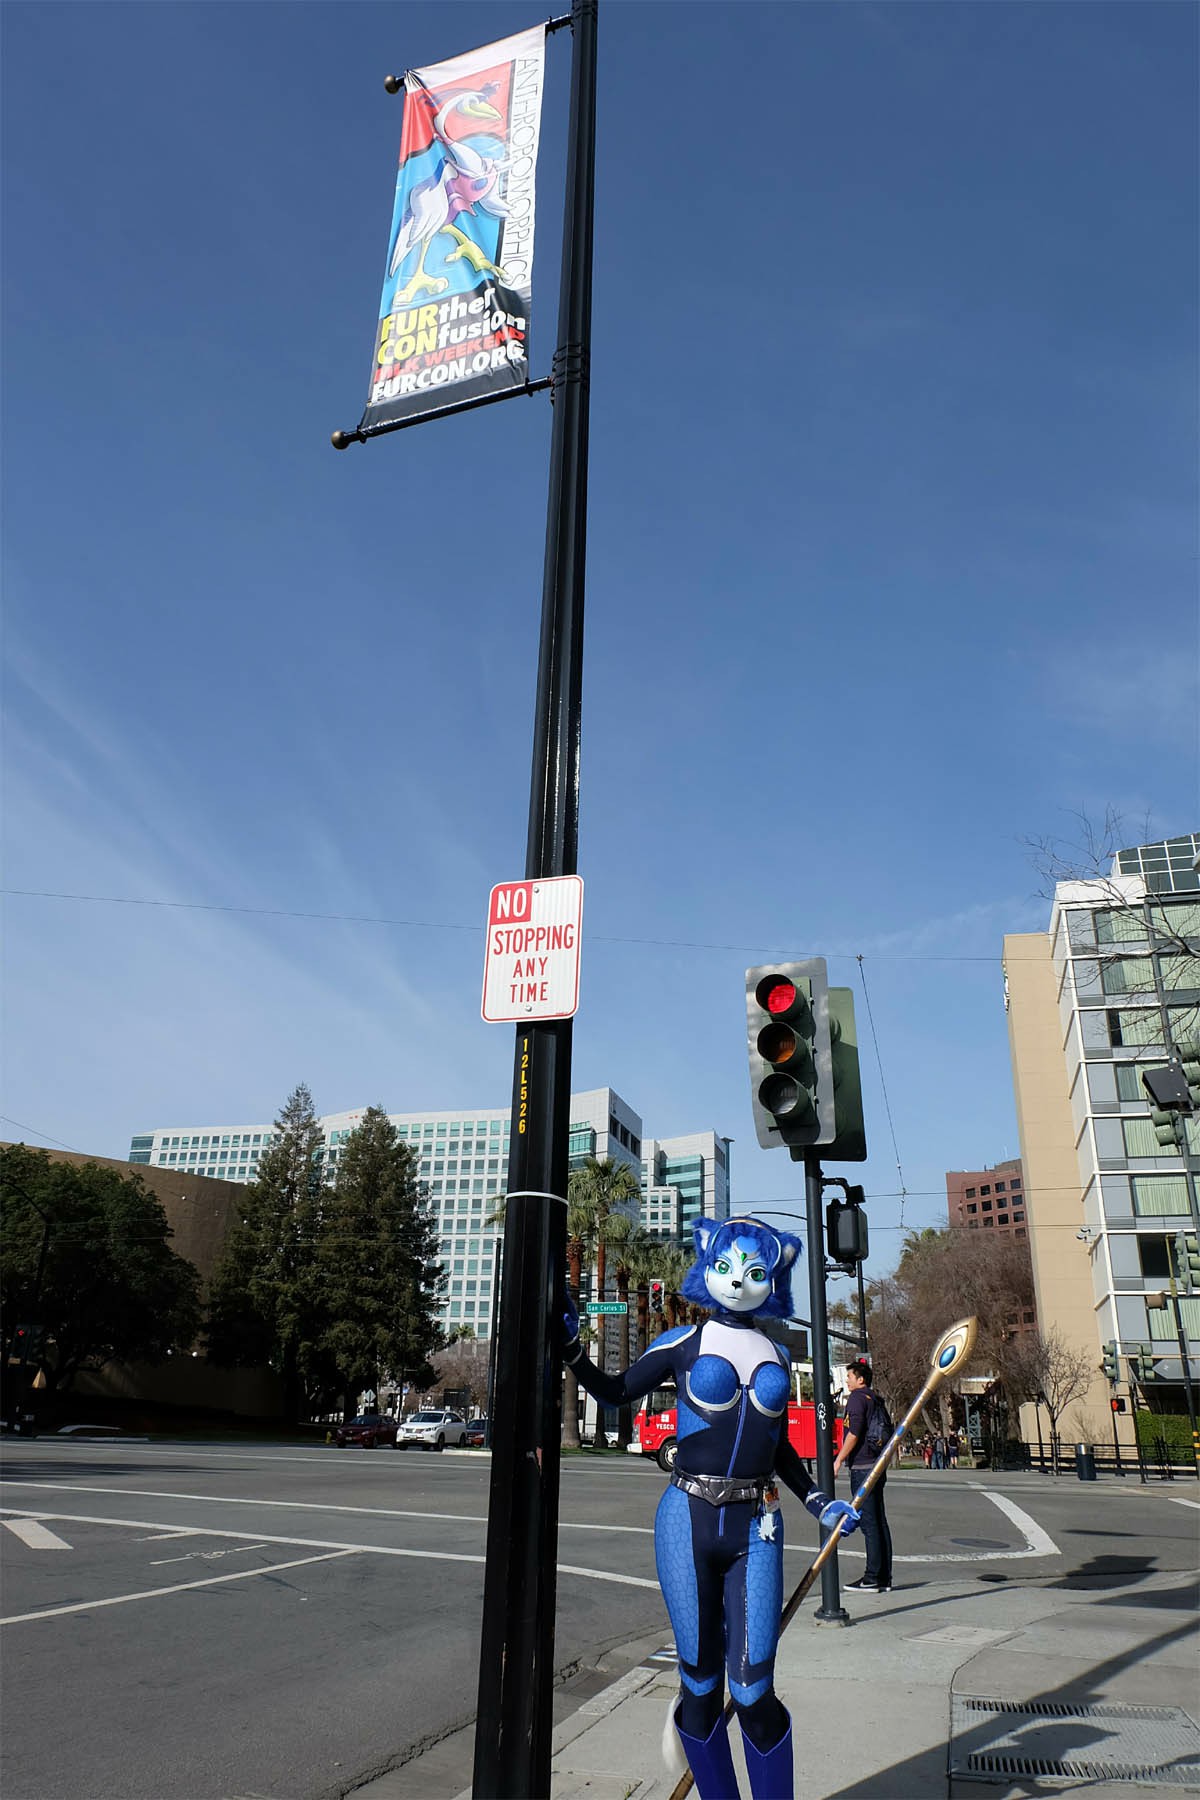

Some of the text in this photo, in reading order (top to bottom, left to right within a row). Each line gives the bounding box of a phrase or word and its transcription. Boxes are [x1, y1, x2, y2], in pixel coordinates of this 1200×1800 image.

[380, 288, 496, 343] FURther
[377, 310, 526, 365] CONfusion
[424, 326, 525, 366] WEEKEND
[371, 339, 528, 403] FURCON.ORG
[496, 887, 527, 919] NO
[493, 923, 574, 955] STOPPING
[512, 956, 548, 978] ANY
[510, 981, 548, 1003] TIME
